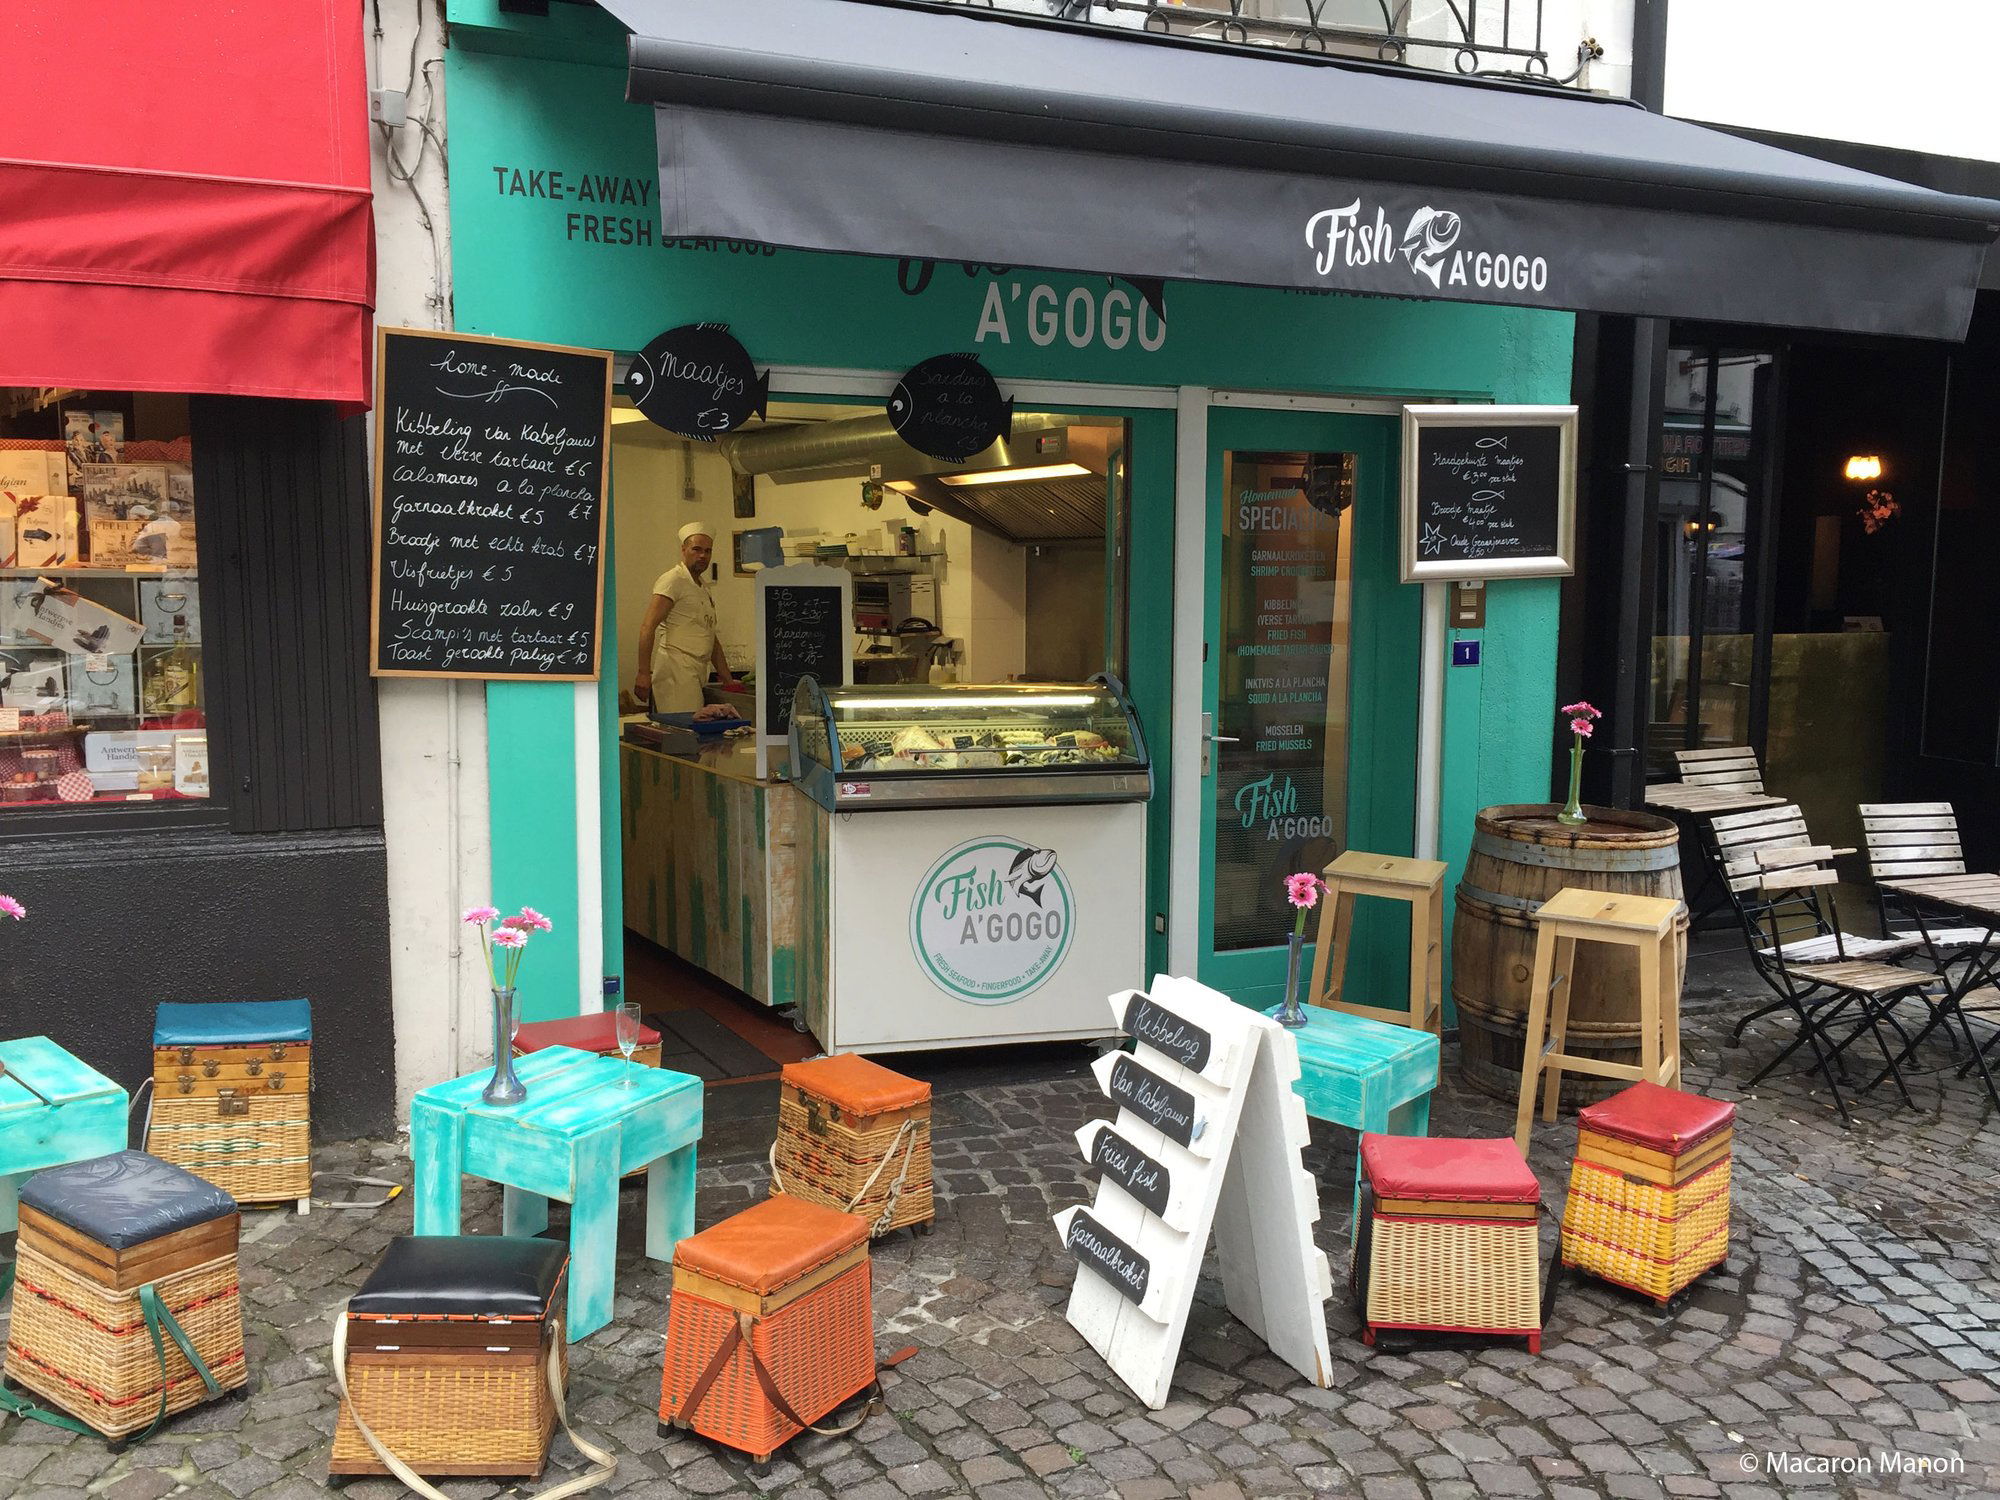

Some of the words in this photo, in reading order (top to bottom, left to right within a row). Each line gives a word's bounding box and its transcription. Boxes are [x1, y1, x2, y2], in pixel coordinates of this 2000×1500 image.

[493, 167, 651, 206] TAKE-AWAY
[567, 213, 652, 247] FRESH
[1304, 197, 1396, 275] Fish
[1448, 251, 1547, 291] A'GOGO
[974, 282, 1167, 352] A'GOGO
[509, 363, 563, 385] made
[659, 350, 745, 401] Maatjes
[396, 406, 472, 448] Kibbeling
[489, 451, 556, 474] tartaar
[517, 478, 535, 496] la
[538, 484, 596, 502] plancha
[387, 527, 440, 555] Broodje
[449, 533, 480, 550] met
[488, 535, 525, 552] echte
[531, 537, 565, 558] krab
[390, 558, 474, 590] Visfrietjes
[1251, 565, 1280, 577] SHRIMP
[391, 588, 488, 626] Huisgerookte
[500, 600, 544, 618] zalm
[478, 627, 503, 643] met
[511, 626, 564, 645] tartaar
[1267, 629, 1288, 640] FRIED
[1290, 628, 1307, 640] FISH
[386, 642, 432, 661] Toast
[445, 645, 505, 668] gerookte
[510, 647, 555, 672] paling
[1464, 647, 1470, 660] 1
[1245, 678, 1273, 689] INKTVIS
[1275, 678, 1280, 688] A
[1282, 678, 1291, 688] LA
[1293, 676, 1326, 688] PLANCHA
[1248, 693, 1270, 704] SQUID
[1272, 693, 1277, 703] A
[1279, 693, 1288, 703] LA
[1289, 691, 1322, 703] PLANCHA
[1256, 740, 1277, 752] FRIED
[1278, 739, 1313, 751] MUSSELS
[1265, 724, 1304, 736] MOSSELEN
[1234, 772, 1299, 828] Fish
[1267, 815, 1333, 841] A'GOGO
[934, 865, 1006, 920] Fish
[960, 910, 1061, 945] A'GOGO
[933, 952, 951, 973] FRESH
[948, 969, 976, 988] SEAFOOD
[981, 976, 1022, 991] FINGERFOOD
[1024, 944, 1053, 977] TAKE-AWAY
[1134, 1000, 1200, 1064] Kibbeling
[1096, 1133, 1129, 1176] Fried
